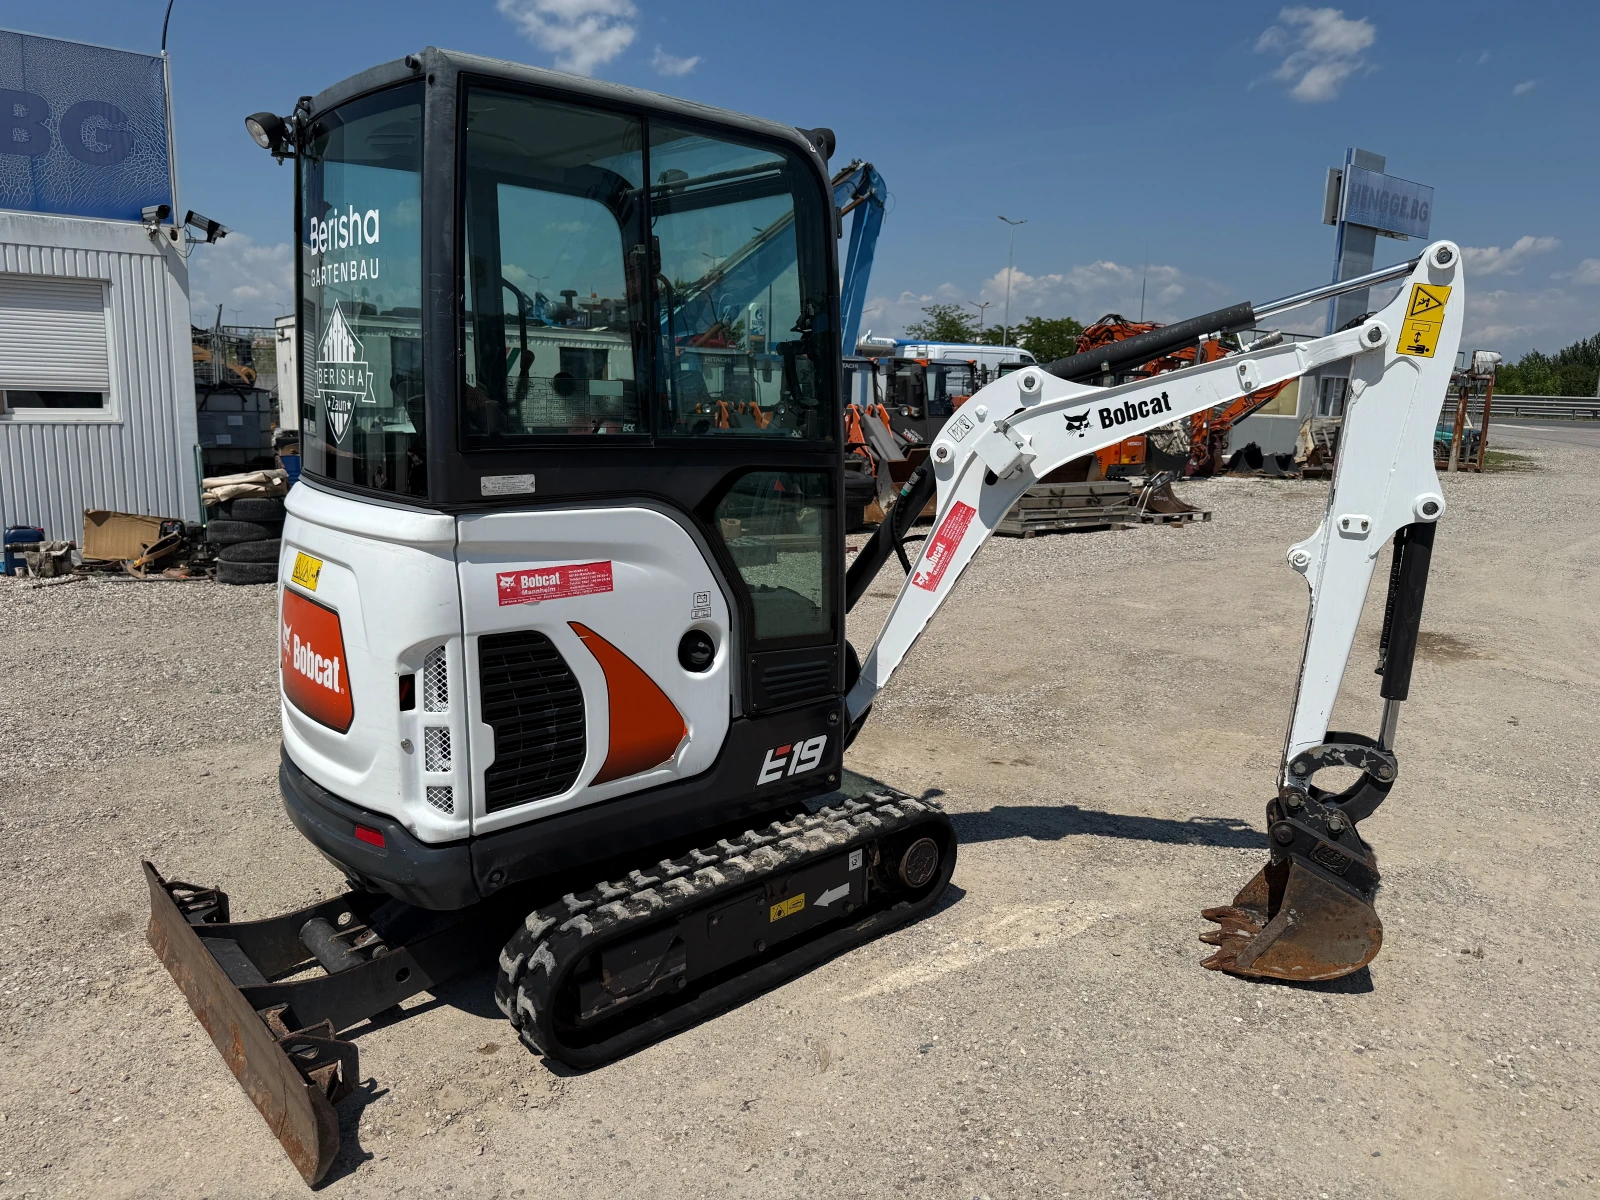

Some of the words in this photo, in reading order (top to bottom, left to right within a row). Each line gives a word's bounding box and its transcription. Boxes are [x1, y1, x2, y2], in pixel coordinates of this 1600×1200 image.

[310, 205, 380, 256] Berisha
[311, 257, 379, 287] GARTENBAU
[704, 356, 732, 364] HITACHI
[318, 368, 365, 387] BERISHA
[331, 395, 347, 411] Zaun
[1098, 391, 1172, 430] Bobcat
[521, 572, 560, 588] Bobcat
[521, 586, 556, 595] Mannheim
[293, 633, 340, 693] Bobcat
[756, 734, 828, 786] E19
